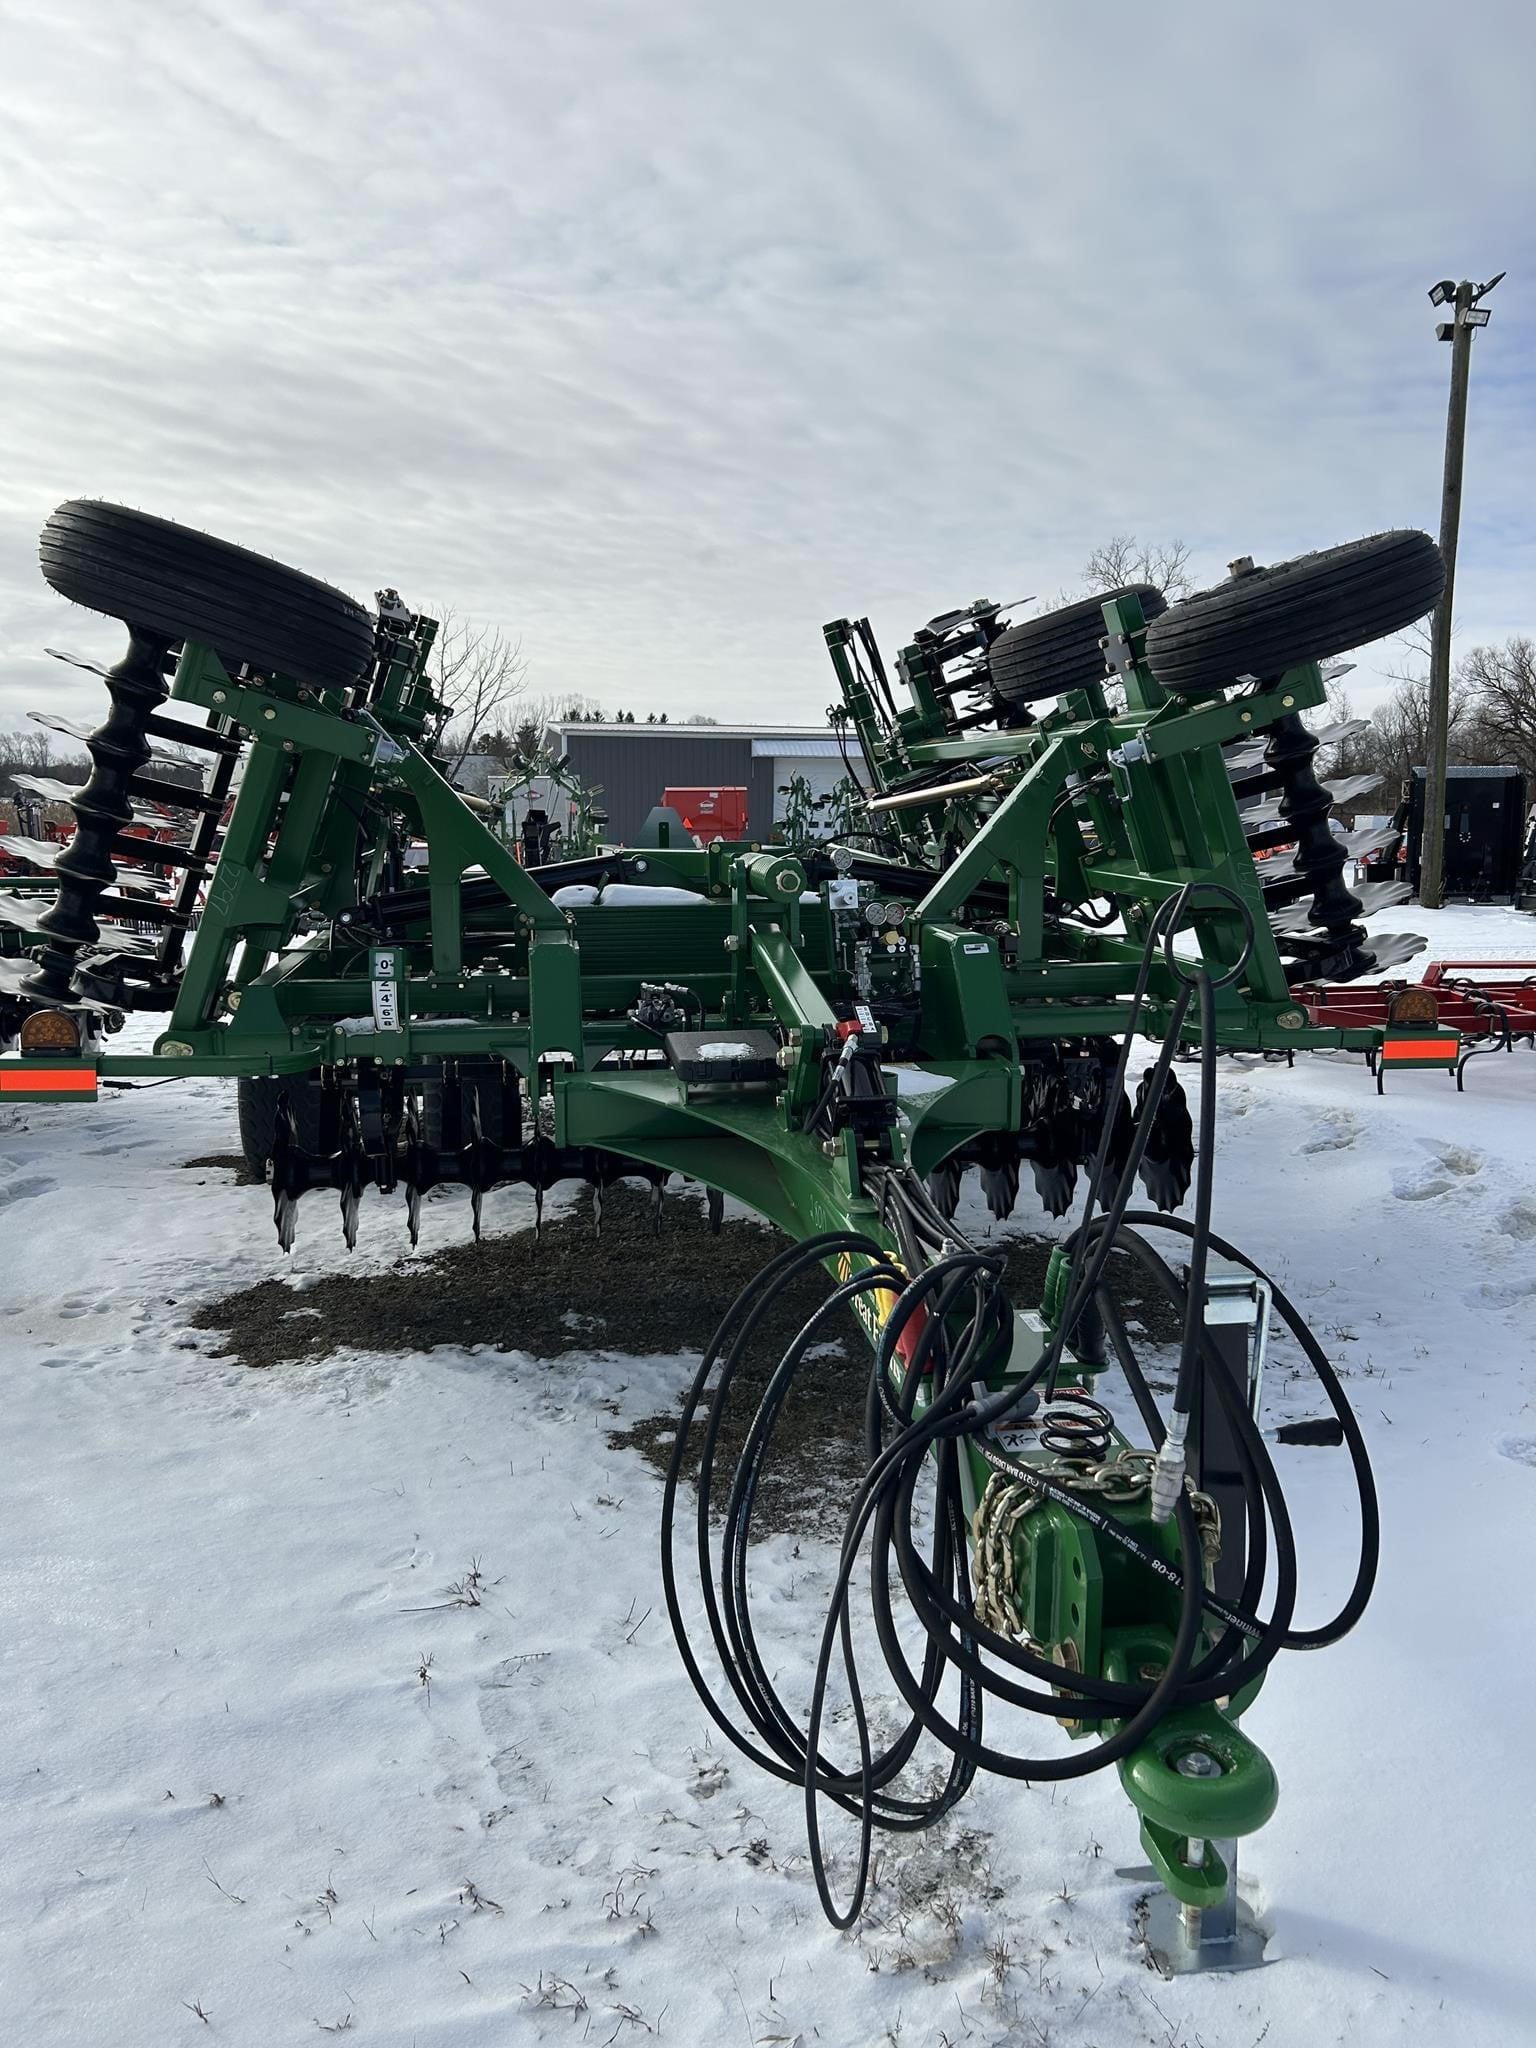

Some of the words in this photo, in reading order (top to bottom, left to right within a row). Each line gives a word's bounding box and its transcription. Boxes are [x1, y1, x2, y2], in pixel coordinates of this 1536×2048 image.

[1006, 1465, 1018, 1477] BAR
[1018, 1472, 1034, 1486] 210
[1151, 1559, 1185, 1590] 18-08
[1225, 1614, 1261, 1638] Winner
